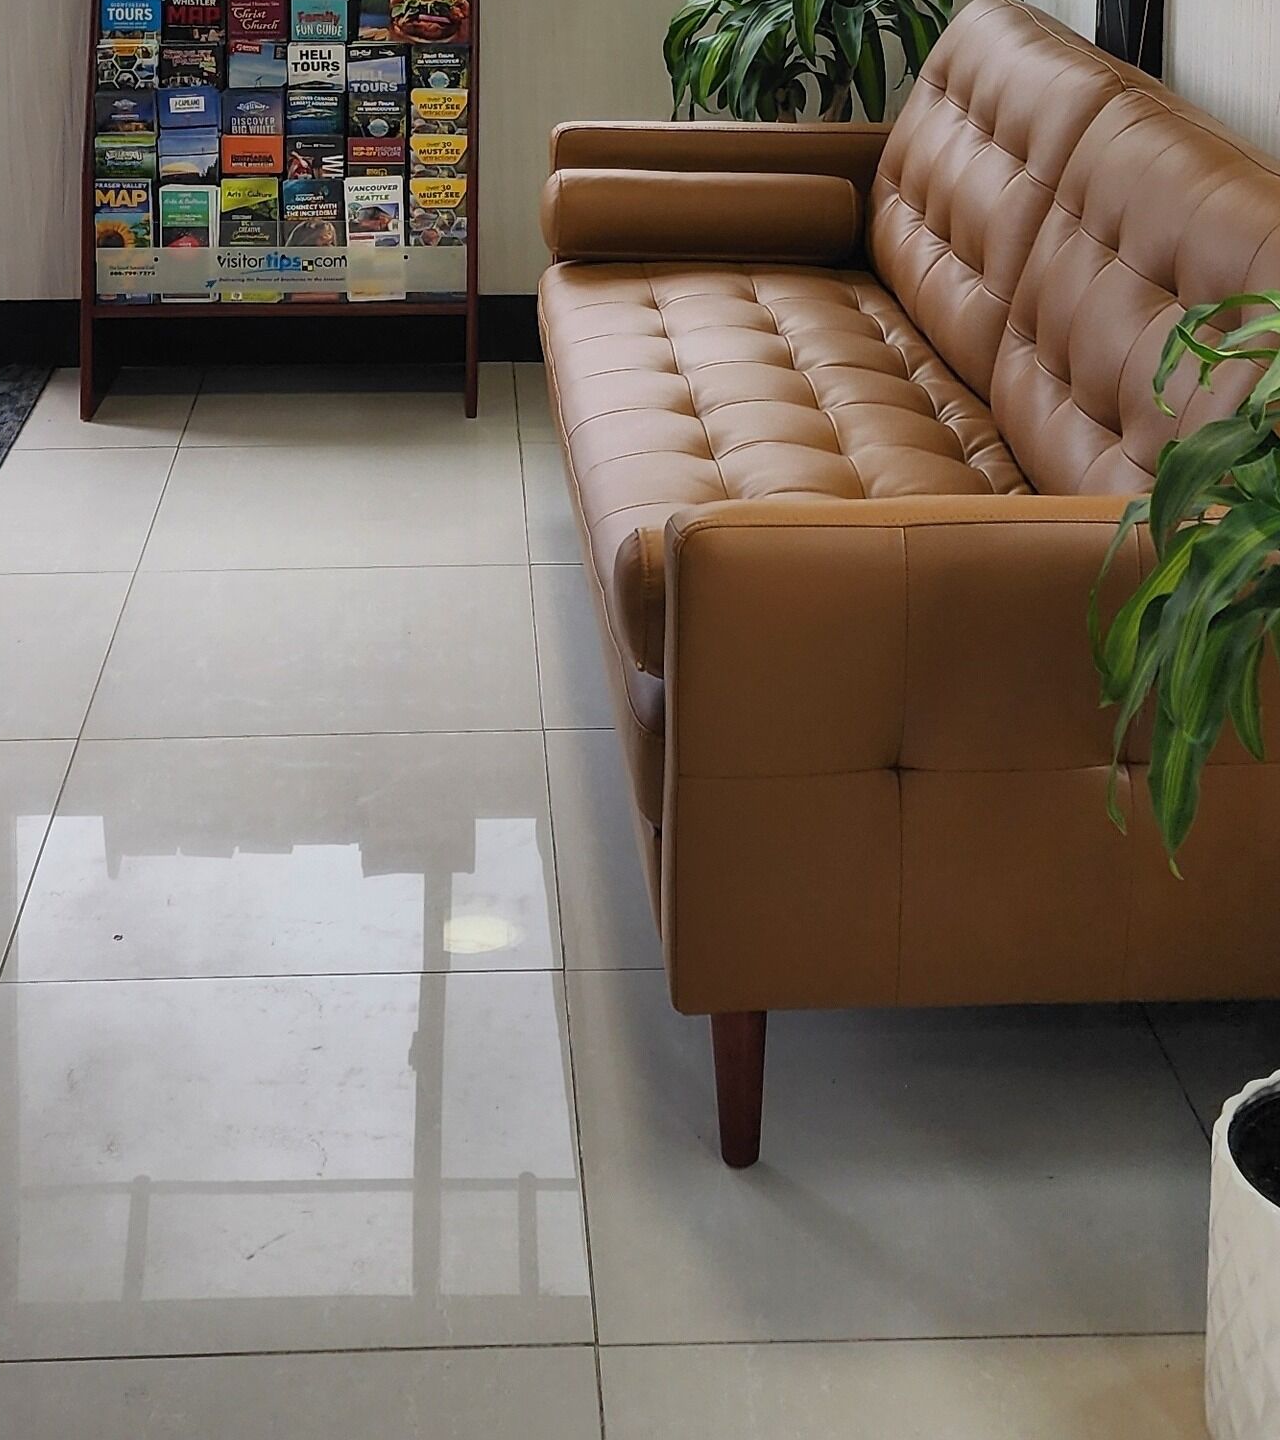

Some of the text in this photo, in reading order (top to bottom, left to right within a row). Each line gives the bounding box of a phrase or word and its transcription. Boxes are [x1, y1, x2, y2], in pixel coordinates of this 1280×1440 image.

[107, 8, 153, 21] TOURS
[169, 7, 220, 23] MAP
[231, 7, 266, 19] Christ
[240, 19, 280, 30] Church
[295, 24, 343, 36] FUN GUIDE
[299, 49, 332, 60] HELI
[291, 61, 340, 72] TOURS
[351, 82, 398, 93] TOURS
[442, 96, 452, 104] 30
[231, 117, 275, 125] DISCOVER
[441, 184, 451, 192] 30
[95, 190, 147, 208] MAP
